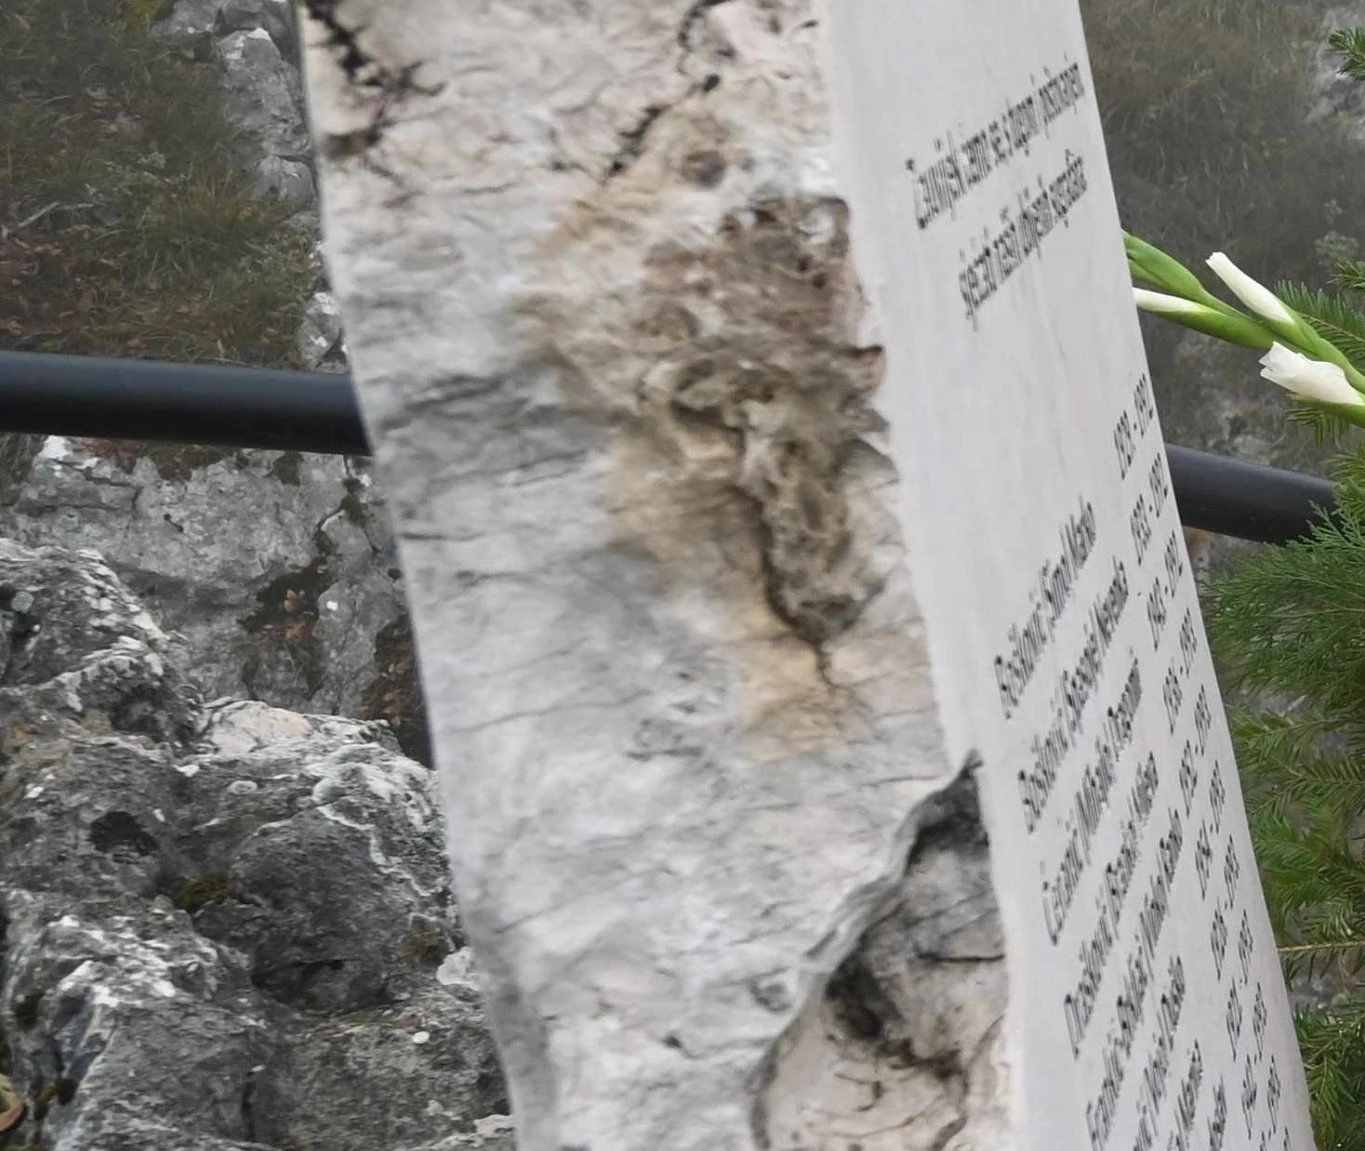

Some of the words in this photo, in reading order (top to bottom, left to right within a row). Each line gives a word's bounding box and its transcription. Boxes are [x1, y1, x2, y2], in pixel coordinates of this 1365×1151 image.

[994, 592, 1047, 720] Bošković
[1065, 495, 1096, 580] Marko
[1017, 700, 1068, 834] Bošković
[1063, 887, 1113, 1061] Drašković
